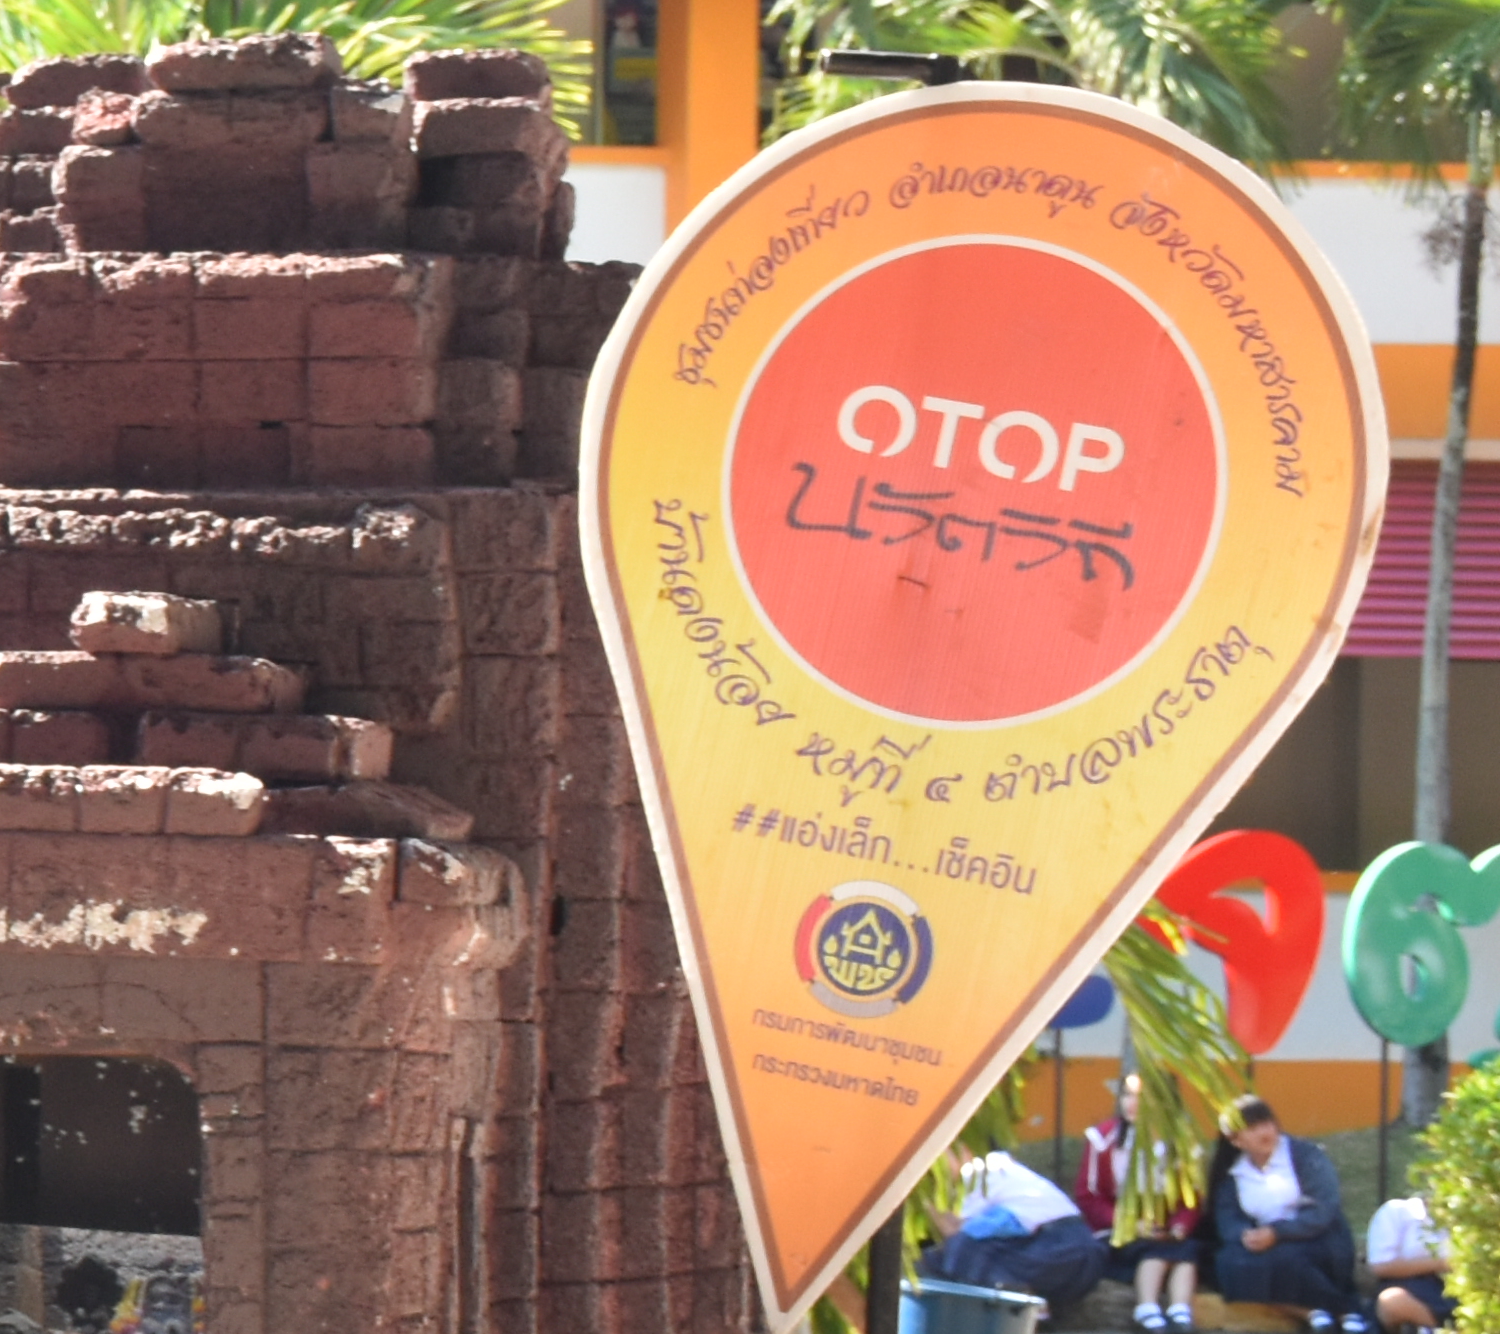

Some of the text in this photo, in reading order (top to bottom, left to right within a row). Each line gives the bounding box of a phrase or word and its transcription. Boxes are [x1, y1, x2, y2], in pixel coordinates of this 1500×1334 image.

[837, 385, 1125, 492] OTOP
[752, 1008, 944, 1067] กรมการพัฒนาชุมชน
